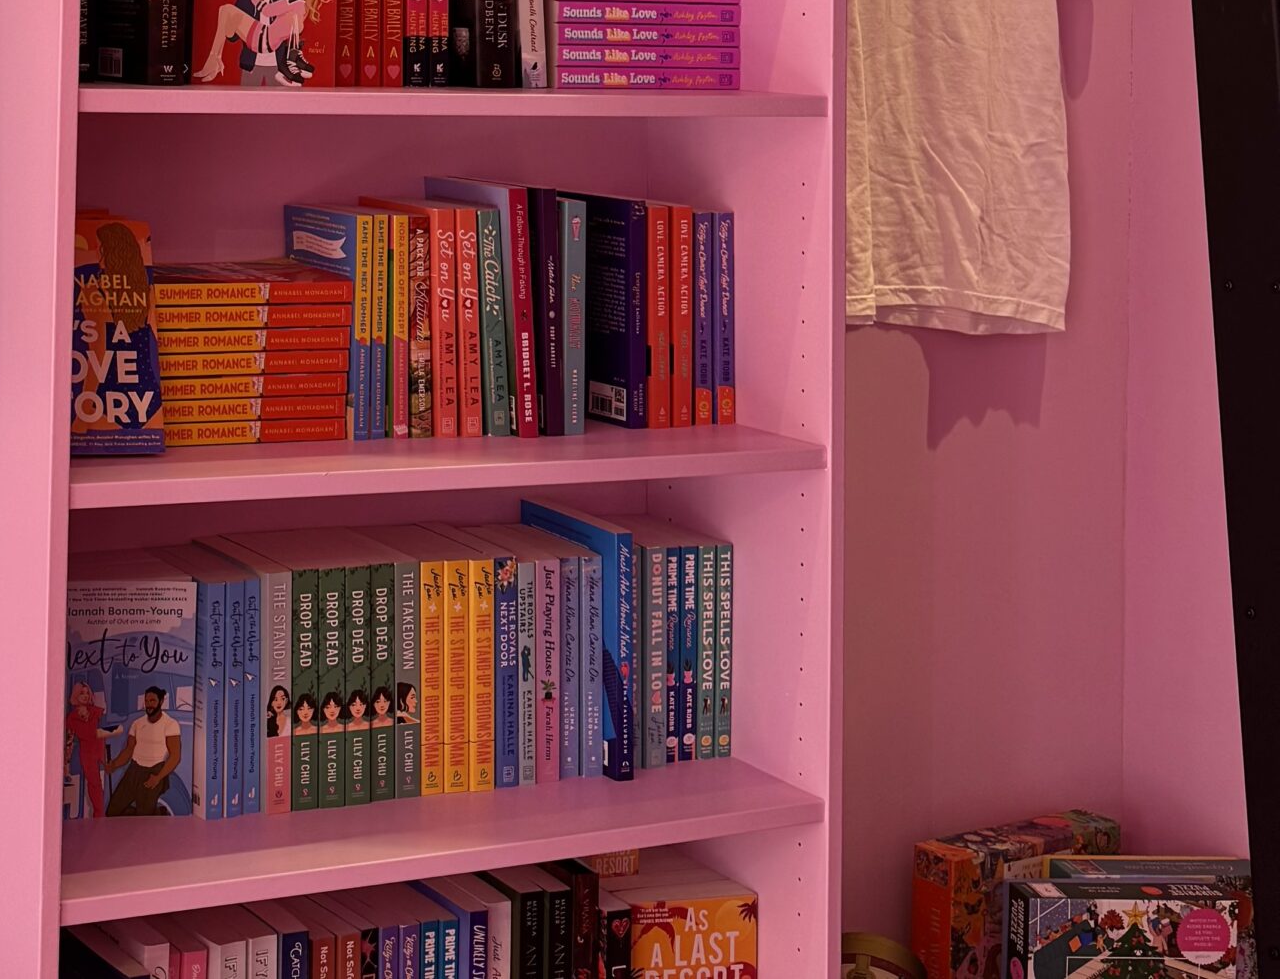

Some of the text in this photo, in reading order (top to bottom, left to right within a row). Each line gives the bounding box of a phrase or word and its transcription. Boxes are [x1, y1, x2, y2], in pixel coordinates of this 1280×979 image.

[436, 229, 454, 259] Set
[74, 273, 131, 290] NABEL
[439, 263, 449, 285] on
[484, 237, 501, 304] The Catch
[76, 291, 147, 307] AGHAN
[71, 351, 139, 383] OVE
[445, 331, 455, 407] AMY LEA
[522, 333, 533, 422] BRIDGET L. ROSE
[74, 391, 154, 423] ORY
[108, 606, 183, 618] Bonam-Young
[273, 583, 286, 681] THE STAND-IN
[299, 593, 312, 667] DROP DEAD
[543, 566, 555, 677] Just Playing House
[720, 551, 731, 691] THIS SPELLS LOVE
[116, 637, 139, 667] to
[140, 635, 188, 673] You
[500, 601, 508, 668] NEXT DOOR
[509, 621, 517, 666] ROYALS
[473, 925, 486, 968] UNLIKELY
[650, 931, 739, 967] A LAST
